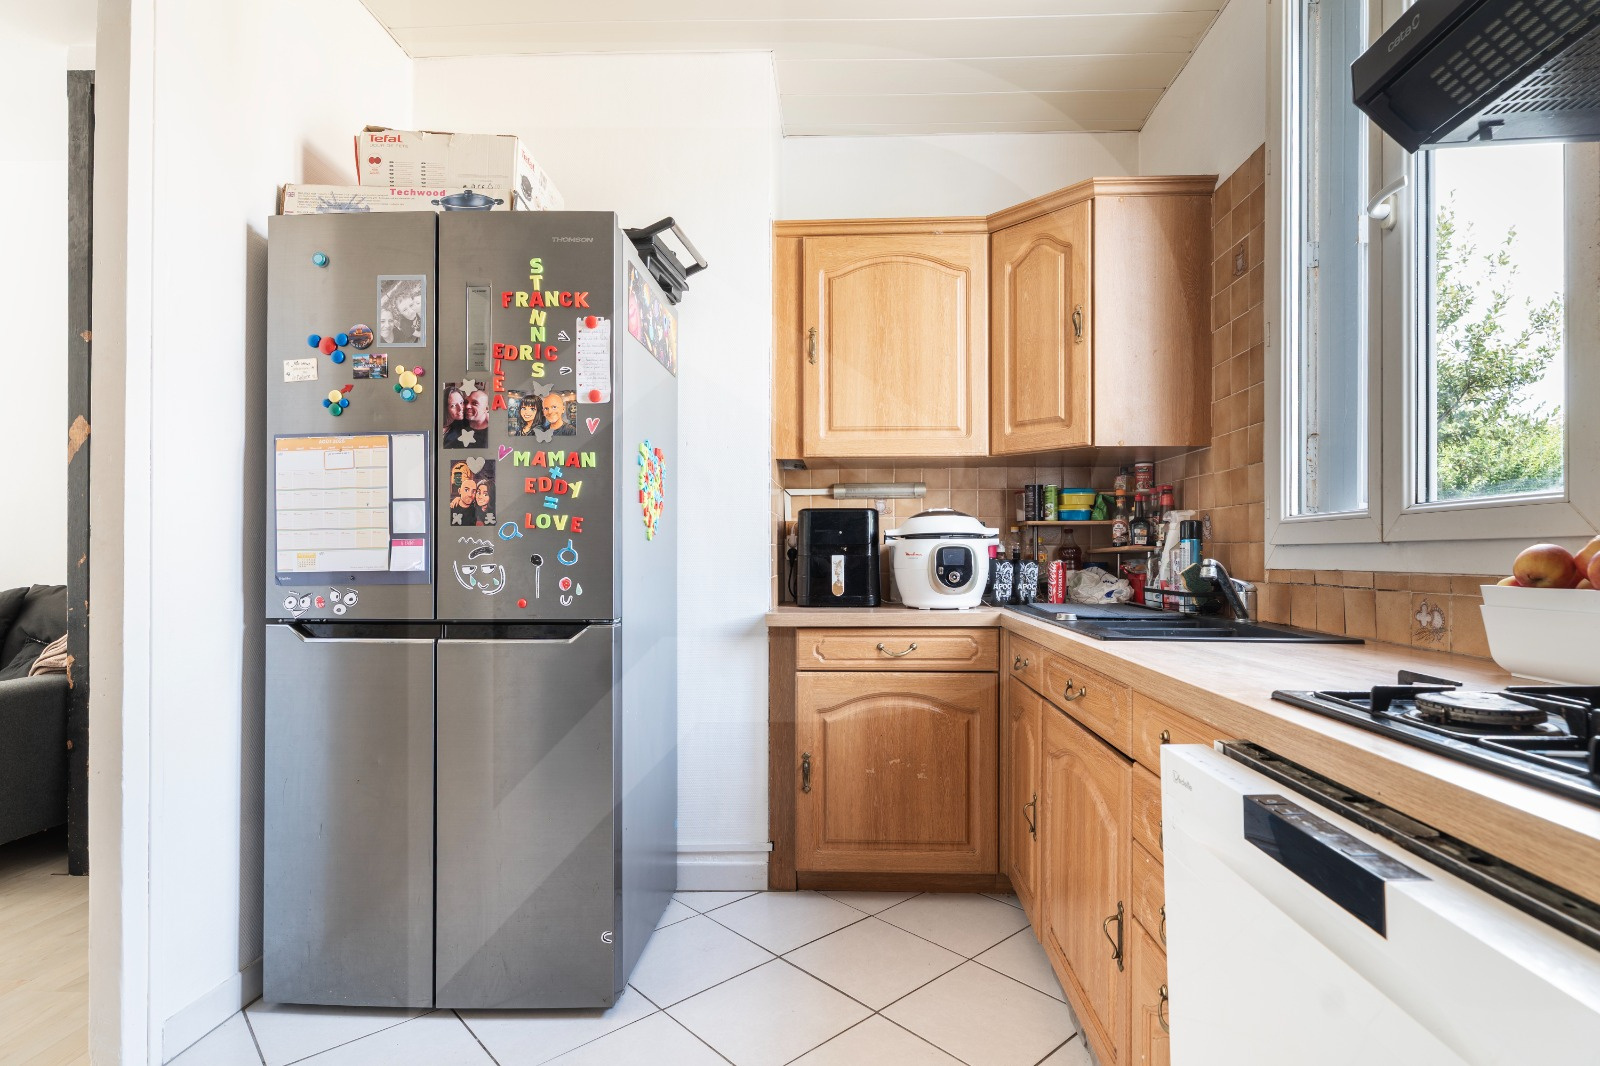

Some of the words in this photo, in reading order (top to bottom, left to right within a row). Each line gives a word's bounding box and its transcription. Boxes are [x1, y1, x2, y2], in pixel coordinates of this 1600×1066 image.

[369, 134, 403, 143] Tefal
[390, 188, 447, 197] Techwood
[501, 291, 590, 308] FRANCK
[492, 343, 558, 361] EDRIC
[513, 450, 597, 468] MAMAN
[524, 477, 582, 499] EDDY
[524, 512, 584, 533] LOVE
